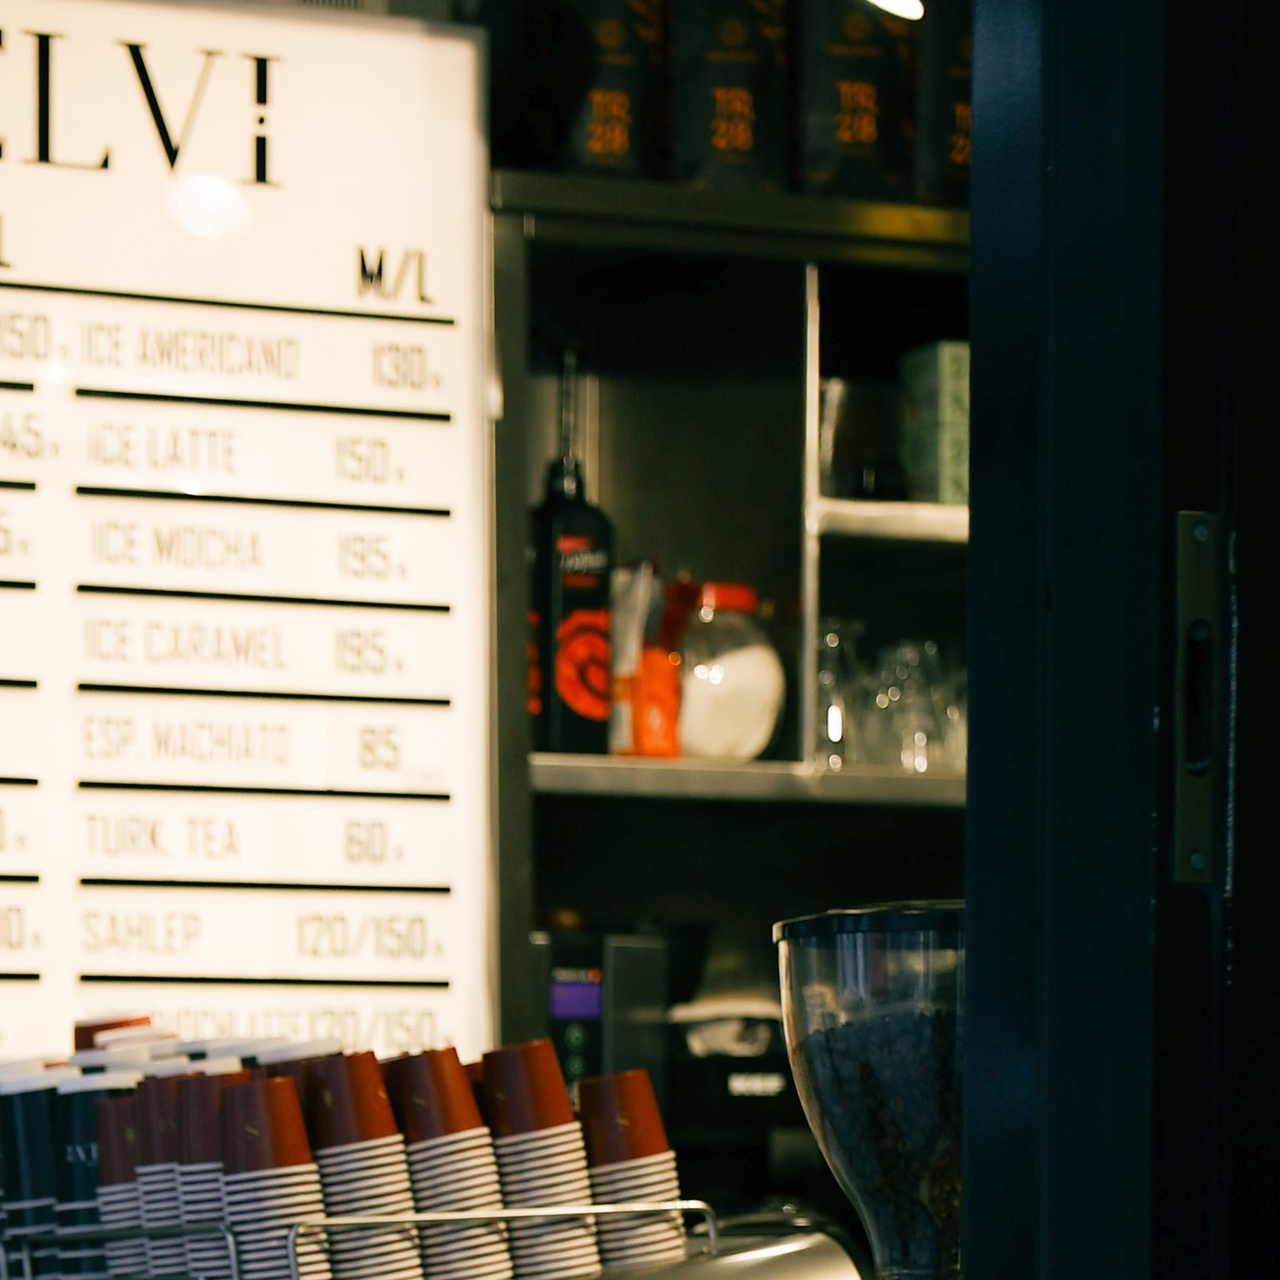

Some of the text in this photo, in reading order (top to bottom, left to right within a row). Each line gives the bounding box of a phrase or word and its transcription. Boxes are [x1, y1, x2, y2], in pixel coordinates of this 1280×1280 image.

[355, 243, 436, 305] M/L
[80, 322, 124, 368] ICE
[136, 328, 299, 381] AMERICANO
[86, 422, 136, 469] ICE
[146, 425, 239, 472] LATTE
[89, 520, 139, 566] ICE
[152, 524, 263, 570] MOCHA
[83, 618, 130, 663] ICE
[144, 620, 286, 671] CARAMEL
[185, 815, 240, 858] TEA
[80, 909, 203, 956] SAHLEP
